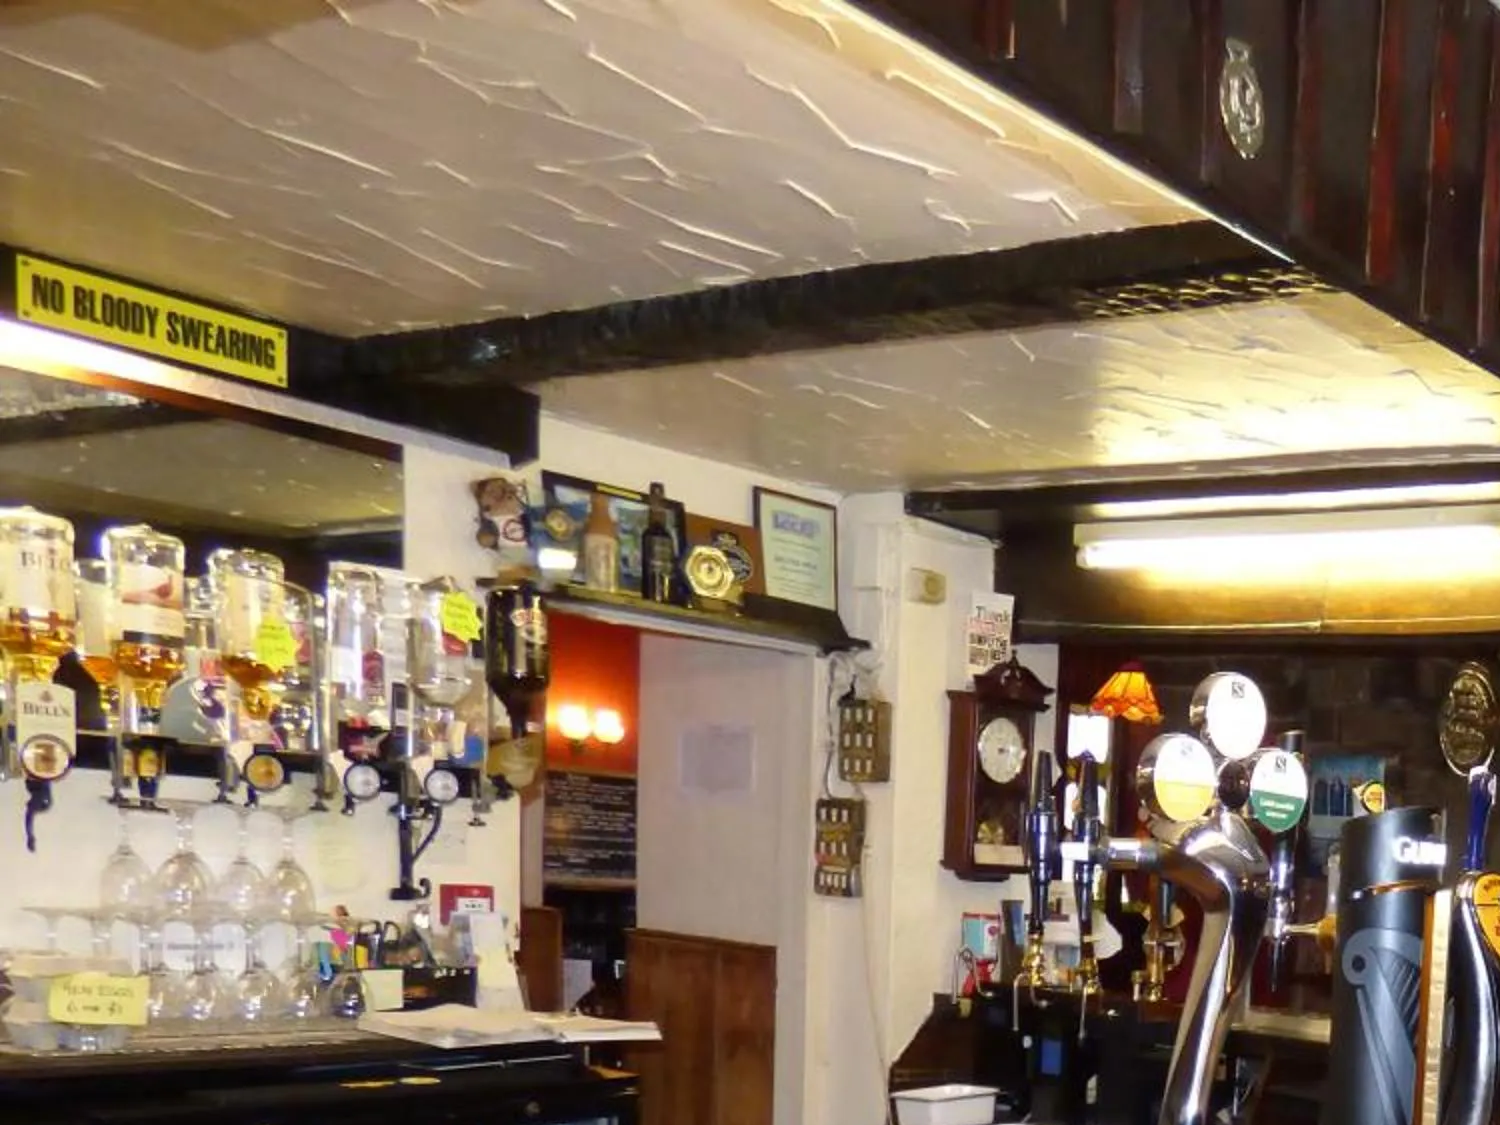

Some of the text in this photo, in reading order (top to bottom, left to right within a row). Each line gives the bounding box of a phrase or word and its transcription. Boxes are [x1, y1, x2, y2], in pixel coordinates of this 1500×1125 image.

[31, 274, 277, 371] NO BLOODY SWEARING
